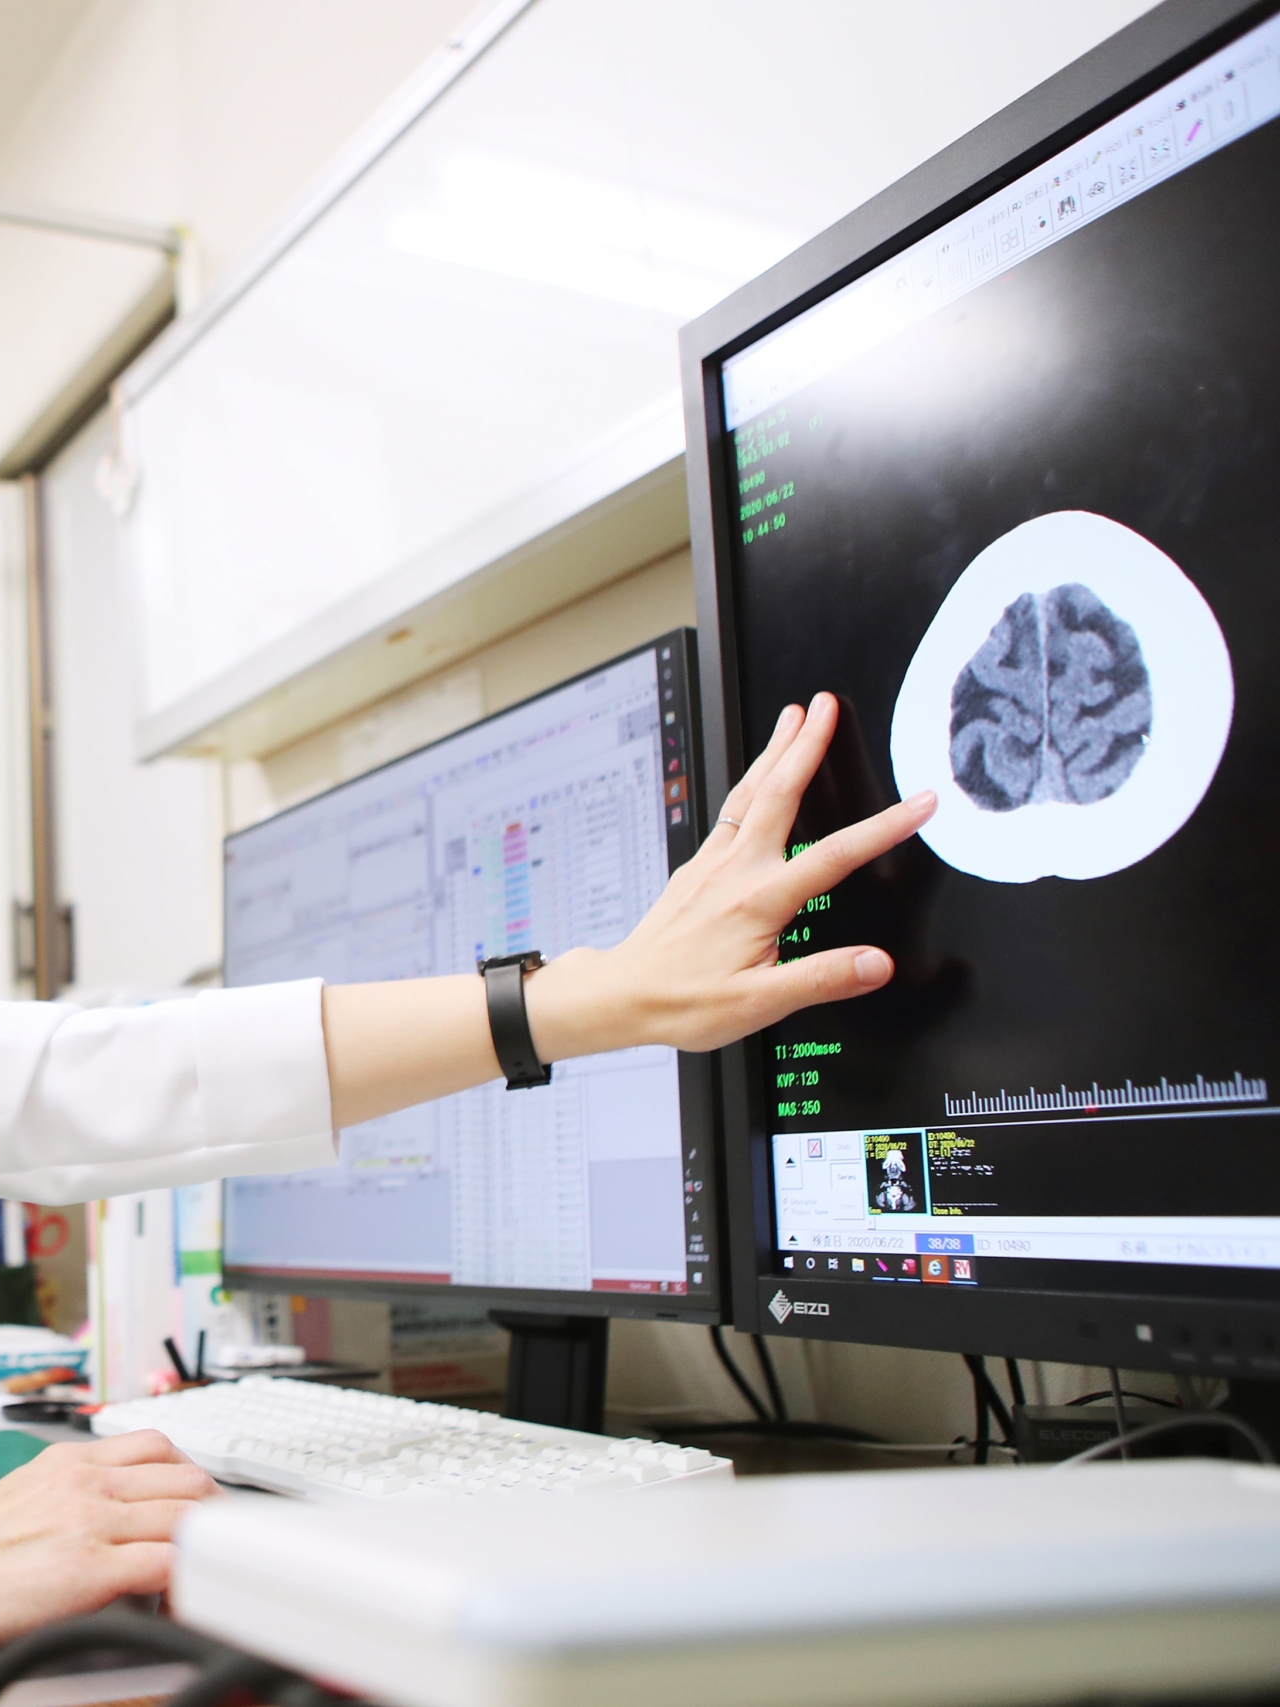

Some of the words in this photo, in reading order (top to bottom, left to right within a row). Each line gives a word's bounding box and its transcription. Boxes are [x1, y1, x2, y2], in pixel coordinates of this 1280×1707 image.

[739, 470, 766, 495] 10490
[740, 481, 795, 521] 2020/06/22
[743, 512, 787, 545] 10:44:50
[776, 1070, 819, 1088] KVP:120
[778, 1099, 821, 1117] MAS:350
[837, 1173, 857, 1182] Series
[933, 1207, 948, 1215] Dose
[847, 1234, 904, 1249] 2020/06/22
[927, 1236, 962, 1251] 38/38
[997, 1239, 1031, 1252] 10490
[954, 1259, 971, 1275] RV
[793, 1301, 830, 1316] EIZO
[1038, 1428, 1112, 1441] ELECOM
